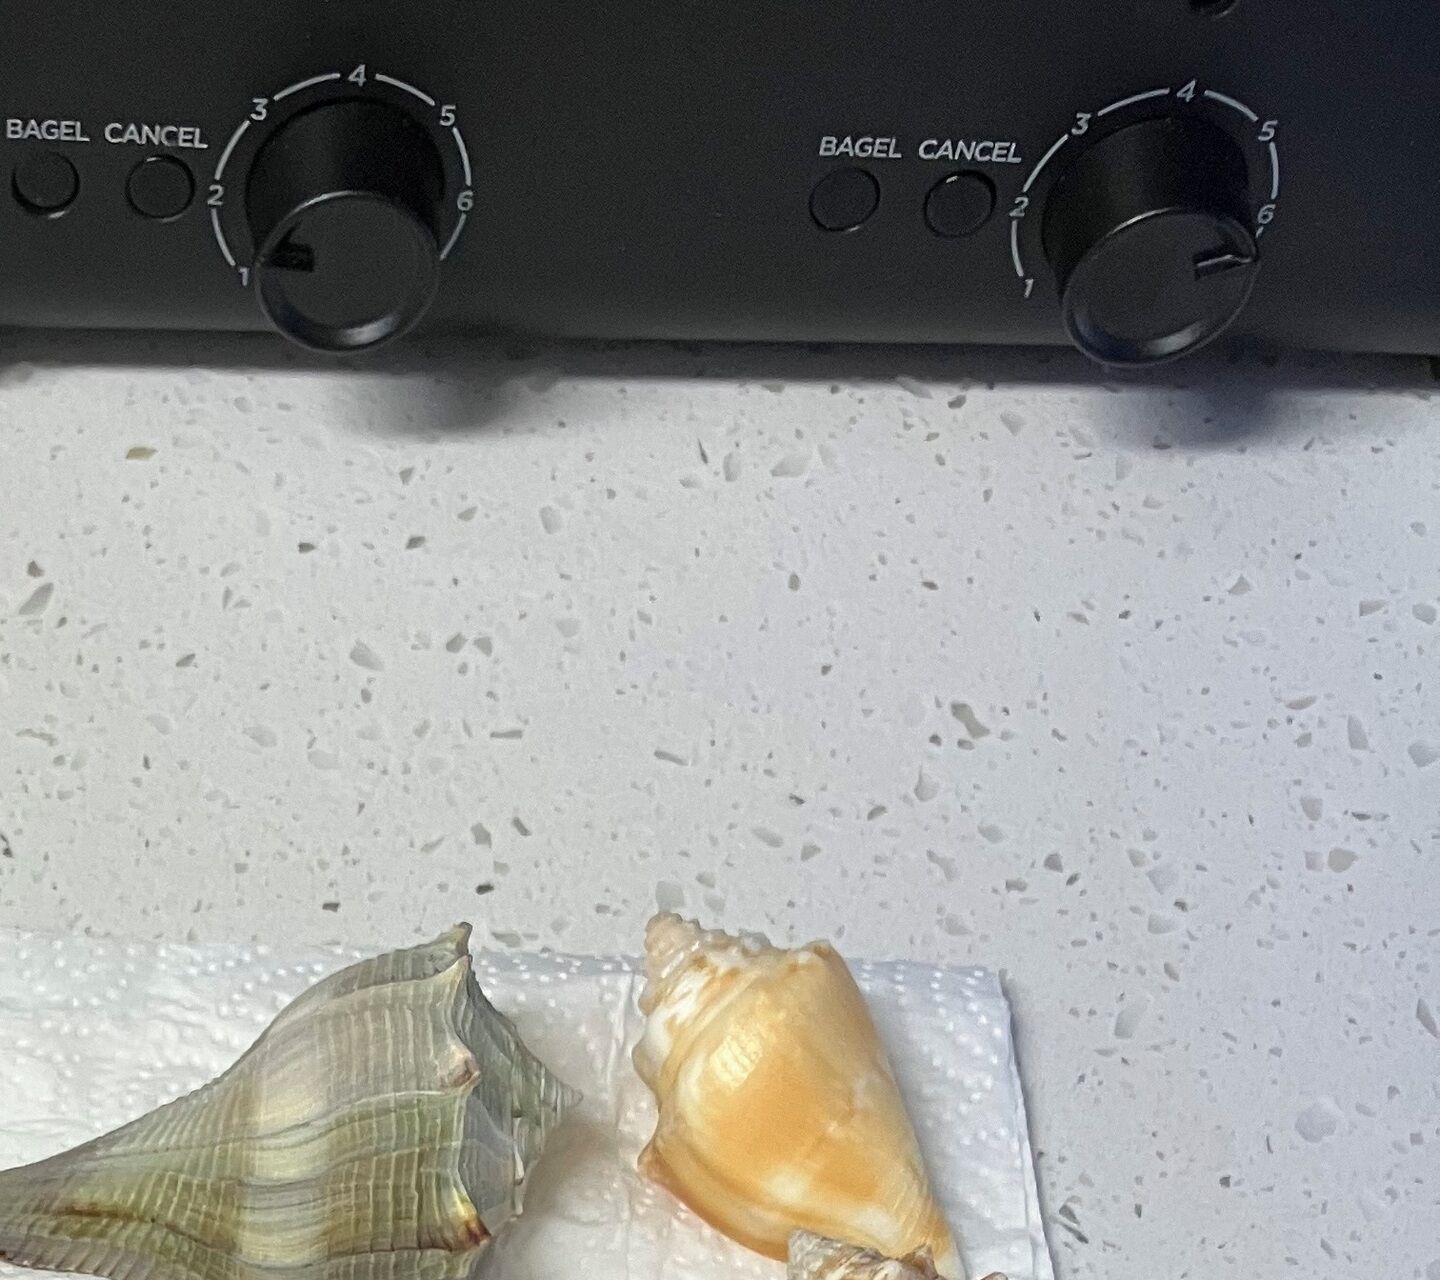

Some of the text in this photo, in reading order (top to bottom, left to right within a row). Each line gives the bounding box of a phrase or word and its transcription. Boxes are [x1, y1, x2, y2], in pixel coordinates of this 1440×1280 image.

[349, 65, 367, 87] 4
[1177, 80, 1198, 102] 4
[252, 98, 269, 121] 3
[441, 105, 456, 127] 5
[6, 119, 209, 149] BAGEL CANCEL
[1072, 113, 1091, 135] 3
[1258, 120, 1278, 141] 5
[819, 136, 1022, 164] BAGEL CANCEL
[208, 185, 224, 206] 2
[457, 190, 474, 212] 6
[1009, 196, 1030, 218] 2
[1257, 204, 1276, 226] 6
[238, 267, 250, 287] 1
[1023, 278, 1035, 299] 1
